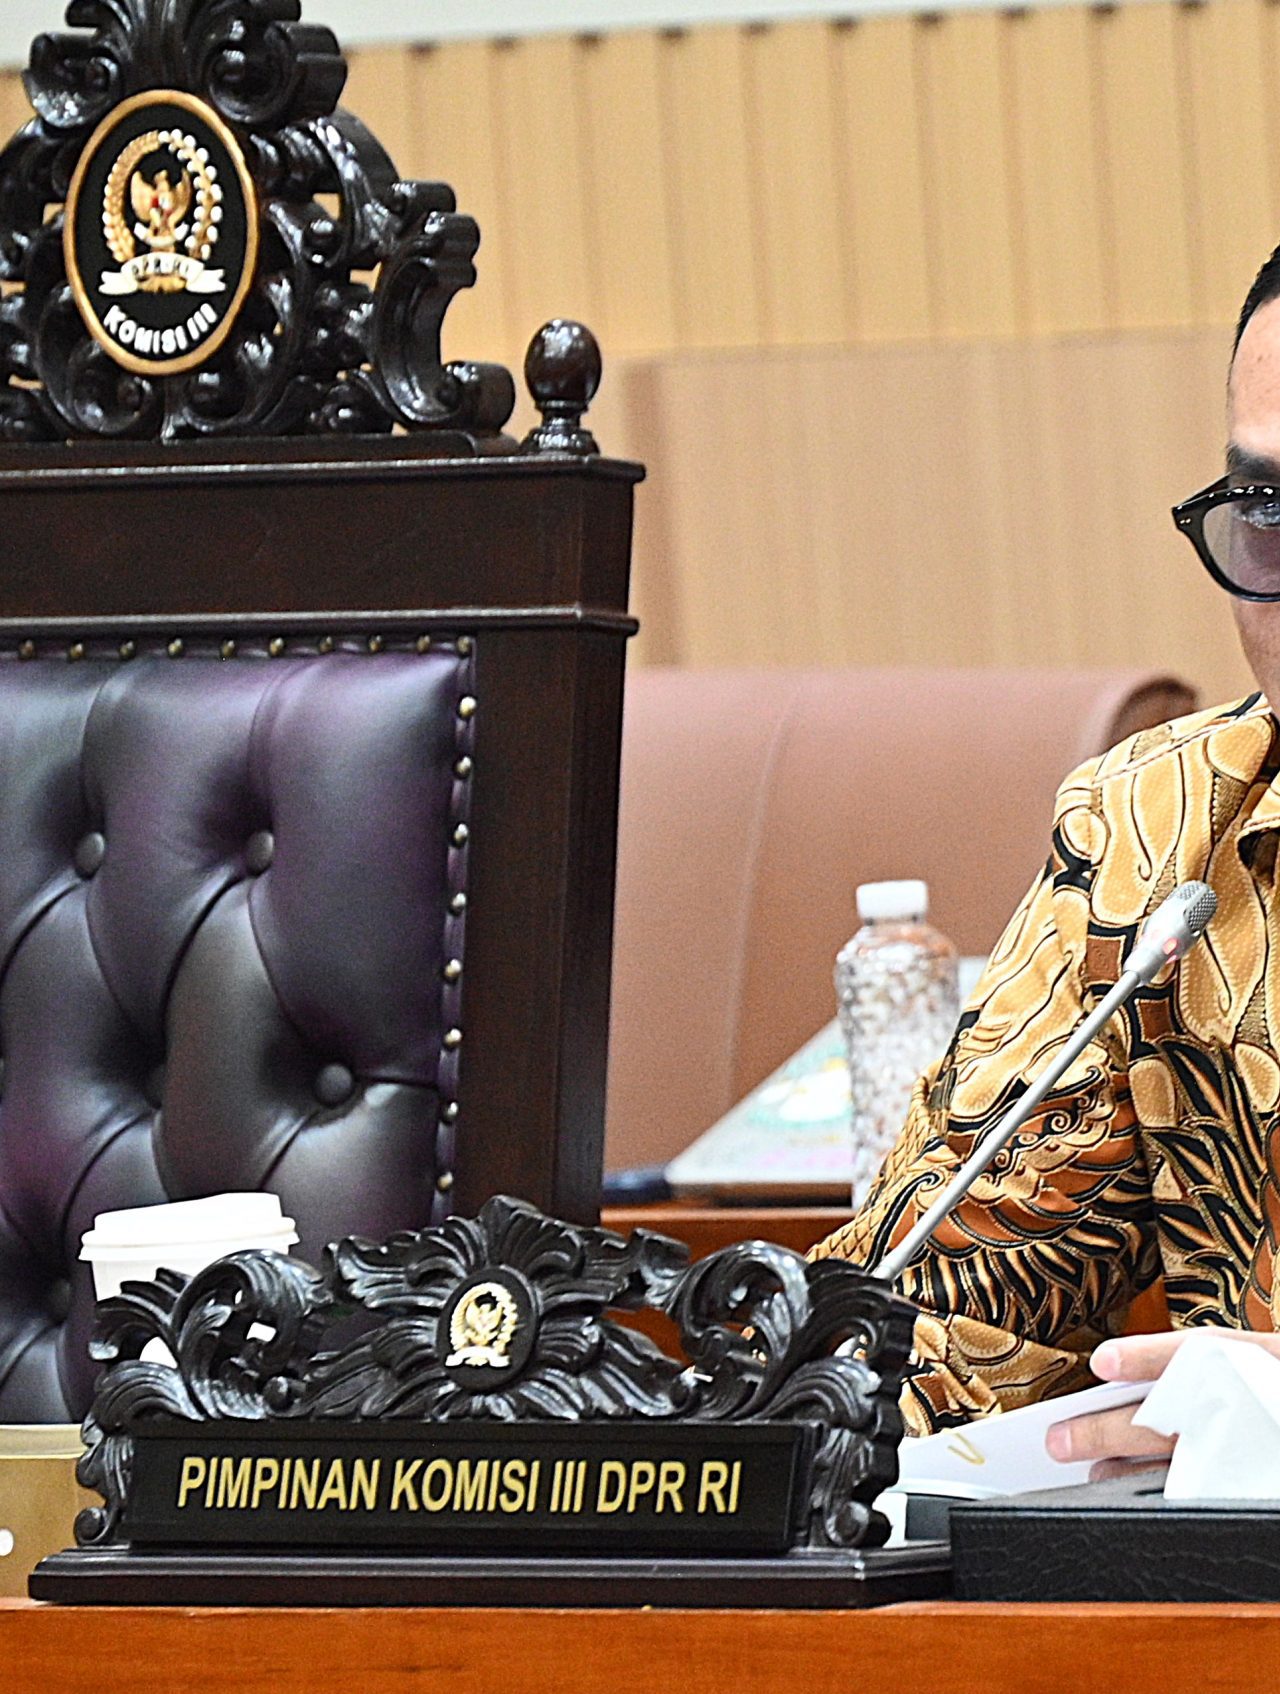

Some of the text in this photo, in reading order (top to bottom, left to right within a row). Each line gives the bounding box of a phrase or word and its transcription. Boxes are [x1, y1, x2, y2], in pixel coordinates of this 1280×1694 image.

[103, 303, 218, 354] KOMISI III
[177, 1456, 742, 1513] PIMPINAN KOMISI III DPR RI
